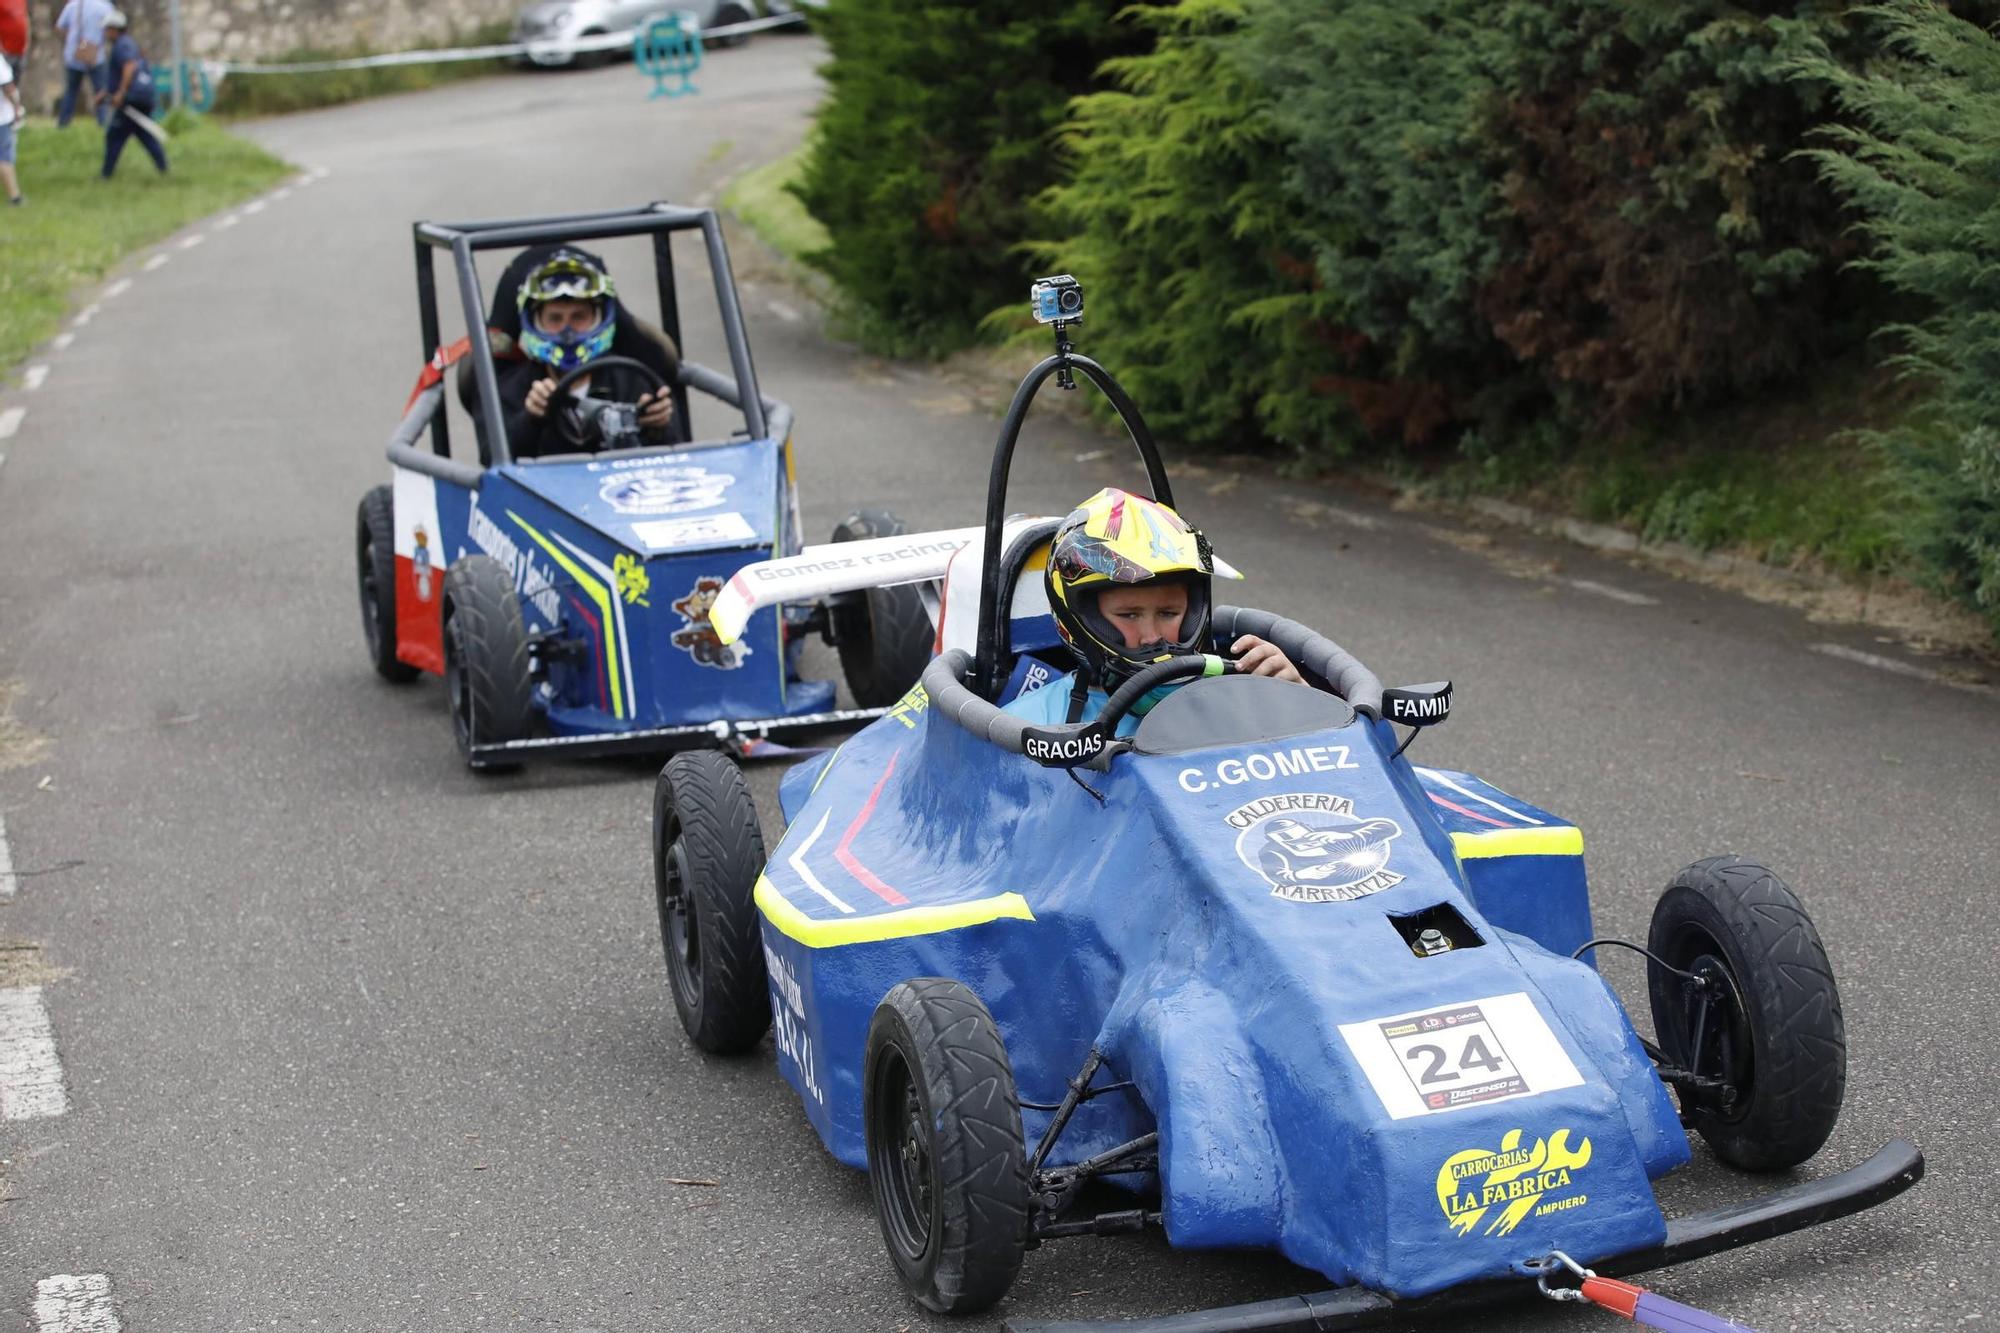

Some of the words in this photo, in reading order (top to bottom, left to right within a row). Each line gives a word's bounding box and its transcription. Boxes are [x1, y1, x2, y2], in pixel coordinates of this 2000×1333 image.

[611, 453, 691, 470] GOMEZ
[753, 557, 858, 582] Gomez
[1025, 733, 1103, 760] GRACIAS
[1228, 794, 1351, 829] CALDERERIA
[1274, 869, 1398, 901] KARRANTZA
[1406, 1033, 1504, 1086] 24
[1452, 1148, 1530, 1180] CARROCERIAS
[1451, 1192, 1479, 1214] LA
[1482, 1168, 1572, 1206] FABRICA
[1535, 1194, 1588, 1217] AMPUERO
